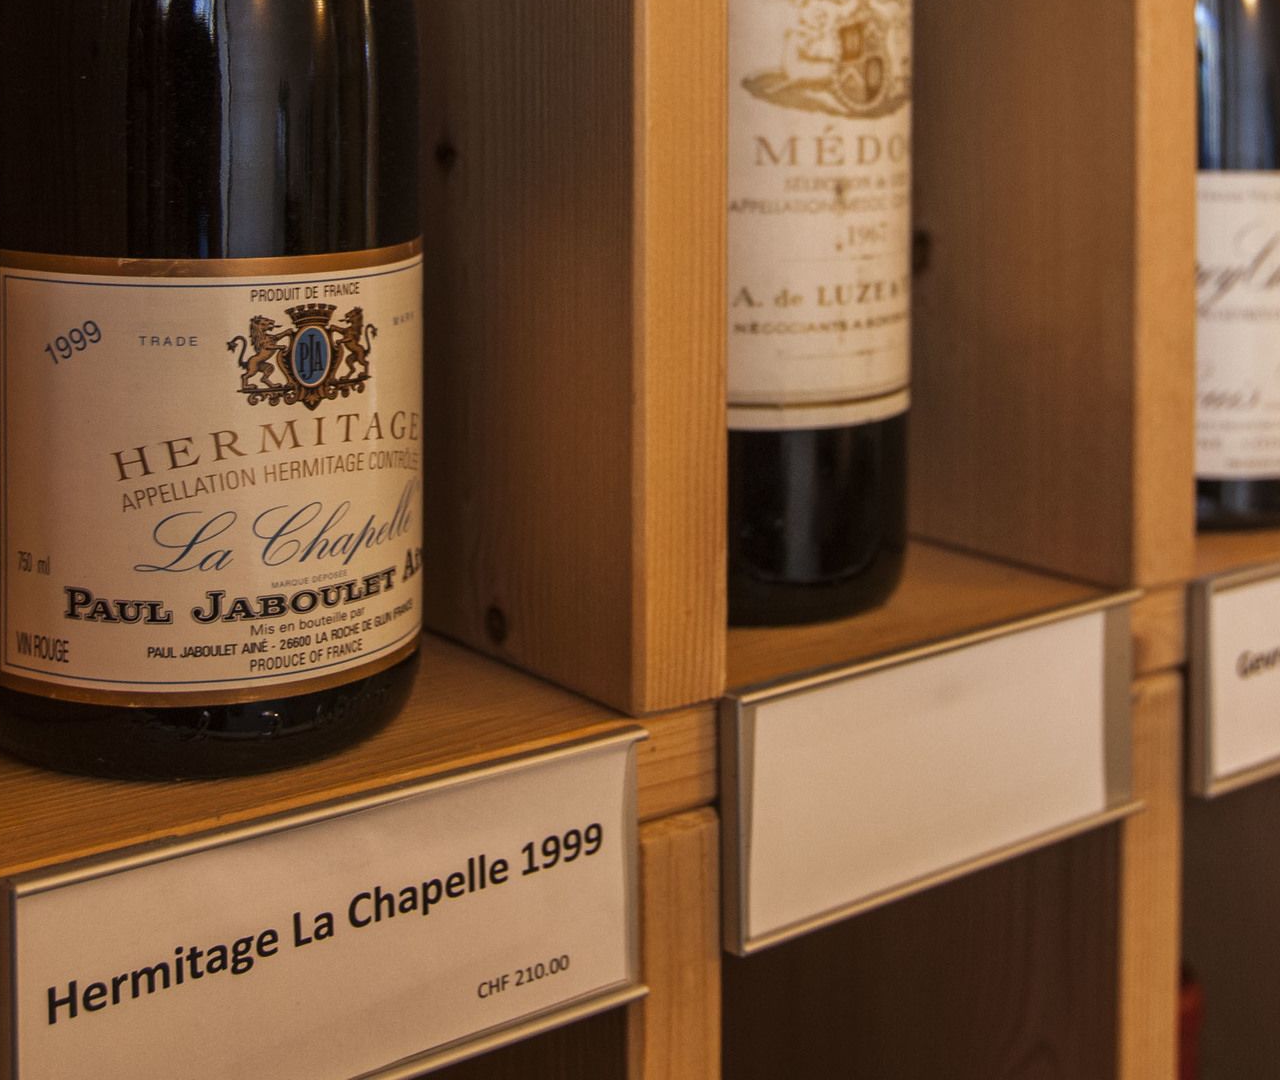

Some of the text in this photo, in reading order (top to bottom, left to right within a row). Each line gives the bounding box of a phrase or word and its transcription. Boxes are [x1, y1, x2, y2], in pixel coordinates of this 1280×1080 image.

[250, 281, 361, 302] PRODUIT DE FRANCE
[44, 320, 103, 365] 1999
[138, 335, 200, 347] TRADE
[110, 409, 419, 482] HERMITAGE
[121, 467, 257, 513] APPELLATION
[264, 452, 365, 485] HERMITAGE
[133, 510, 238, 573] La
[16, 550, 51, 576] 750 ml
[271, 576, 309, 589] MARQUE
[63, 585, 173, 625] PAUL
[190, 565, 398, 625] JABOULET
[147, 645, 177, 659] PAUL
[179, 644, 238, 659] JABOULET
[242, 638, 268, 656] AINÉ
[279, 635, 311, 651] 26600
[315, 632, 329, 645] LA
[331, 627, 360, 641] ROCHE
[362, 618, 373, 632] DE
[250, 607, 366, 637] Mis en bouteille par
[15, 630, 70, 664] VIN ROUGE
[249, 638, 363, 673] PRODUCE OF FRANCE
[45, 821, 604, 1026] Hermitage La Chapelle 1999
[477, 953, 571, 1000] CHF 210.00
